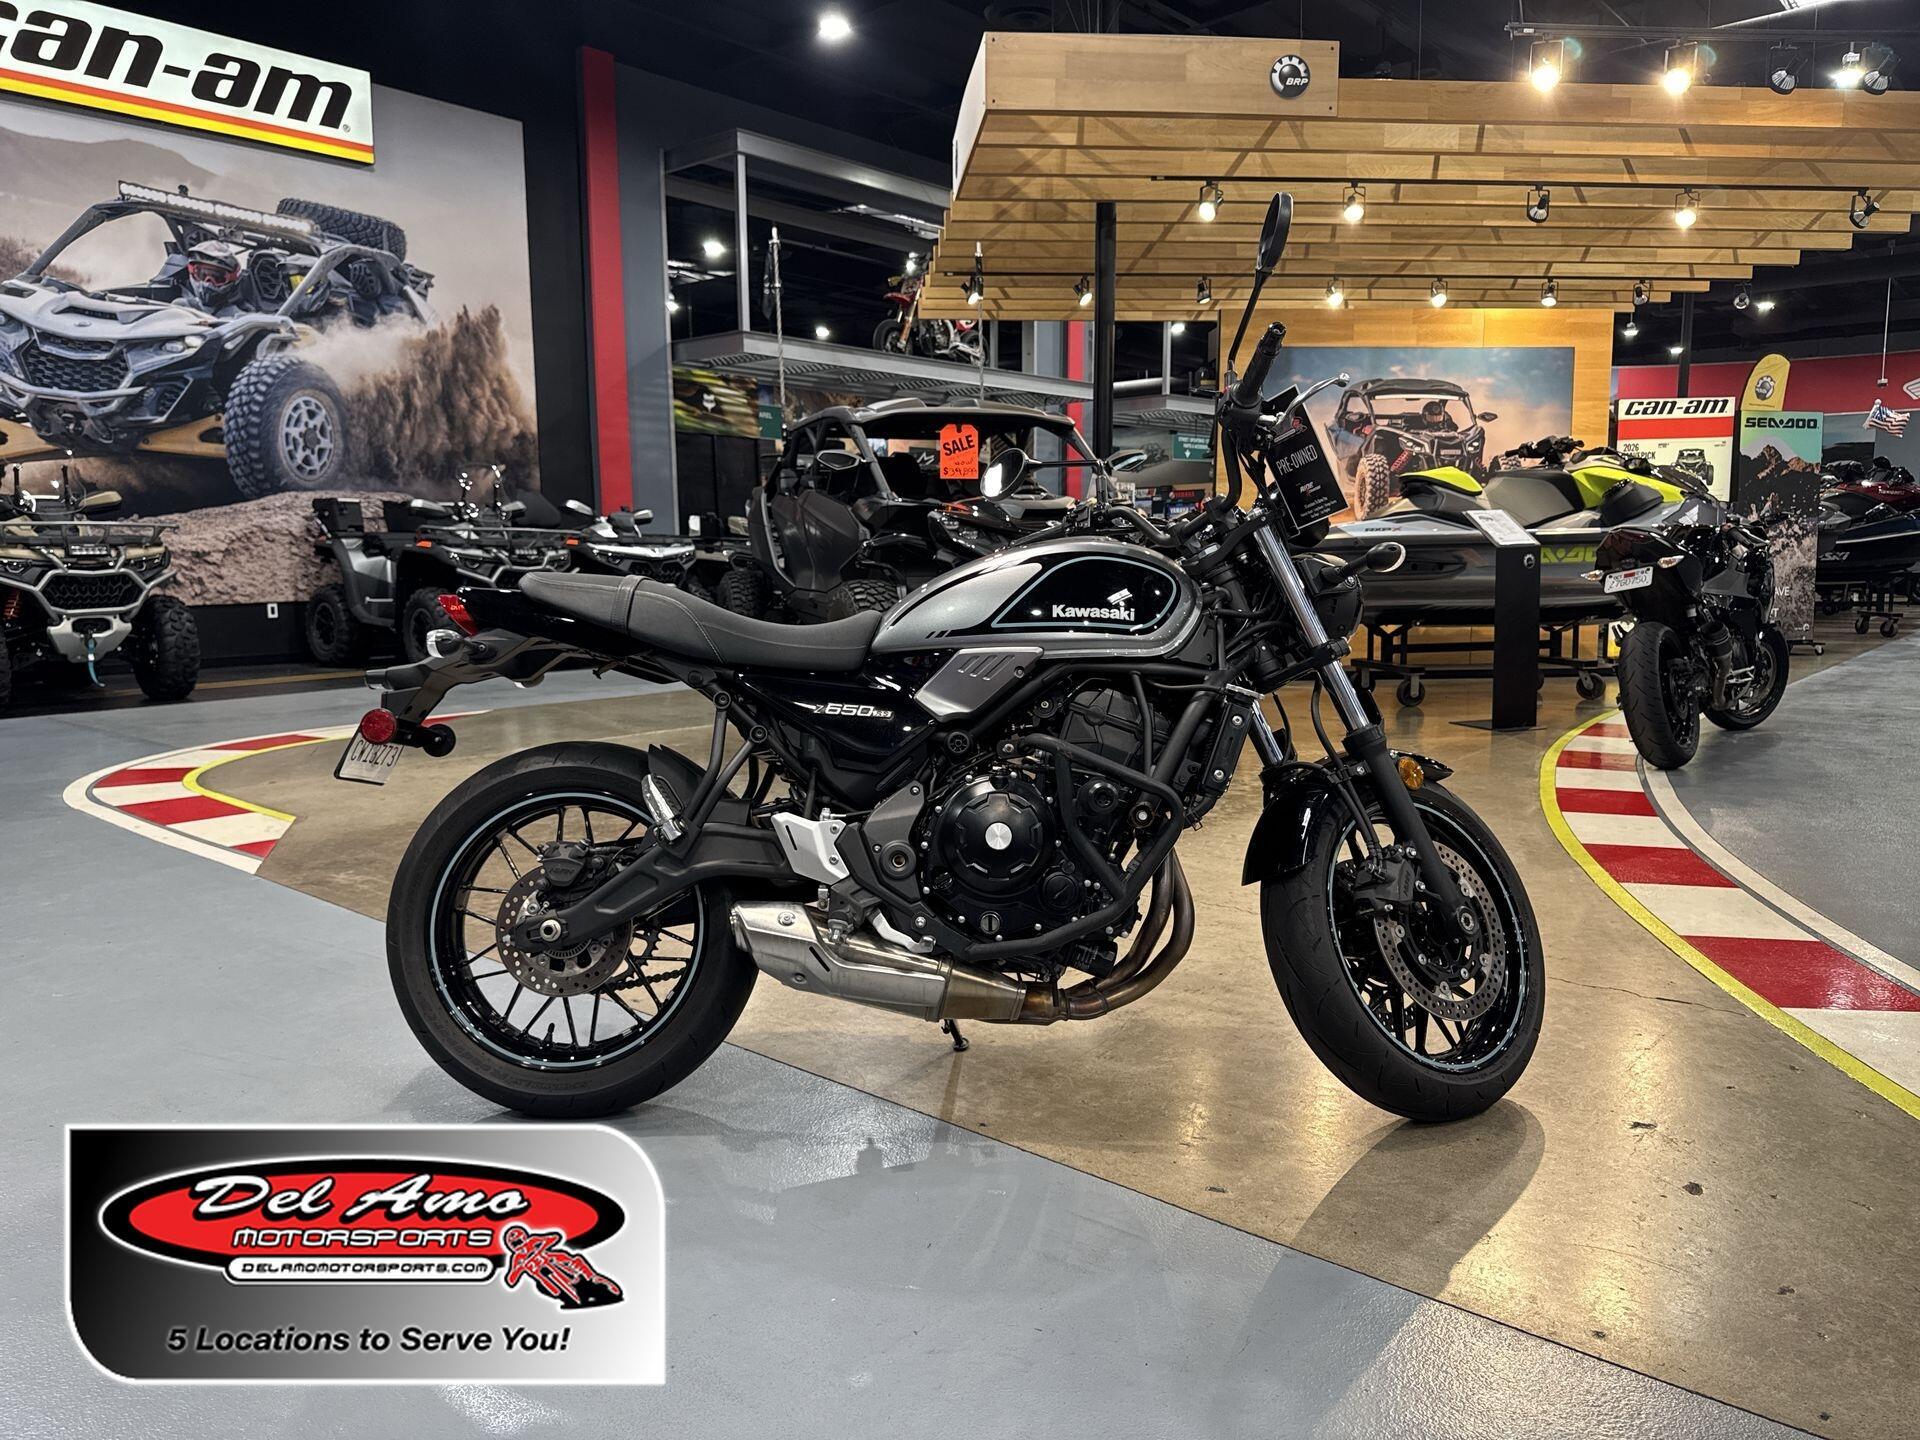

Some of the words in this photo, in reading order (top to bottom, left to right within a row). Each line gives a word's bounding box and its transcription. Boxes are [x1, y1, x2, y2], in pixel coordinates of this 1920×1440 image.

[0, 1, 353, 130] an-am
[1285, 77, 1309, 86] BRP
[759, 412, 773, 420] AREL
[1624, 399, 1729, 416] can-am
[942, 434, 975, 457] SALE
[1623, 443, 1640, 452] 2026
[1276, 444, 1318, 476] PRE-OWNED
[1774, 586, 1790, 596] AVE
[1052, 604, 1135, 621] Kawasaki
